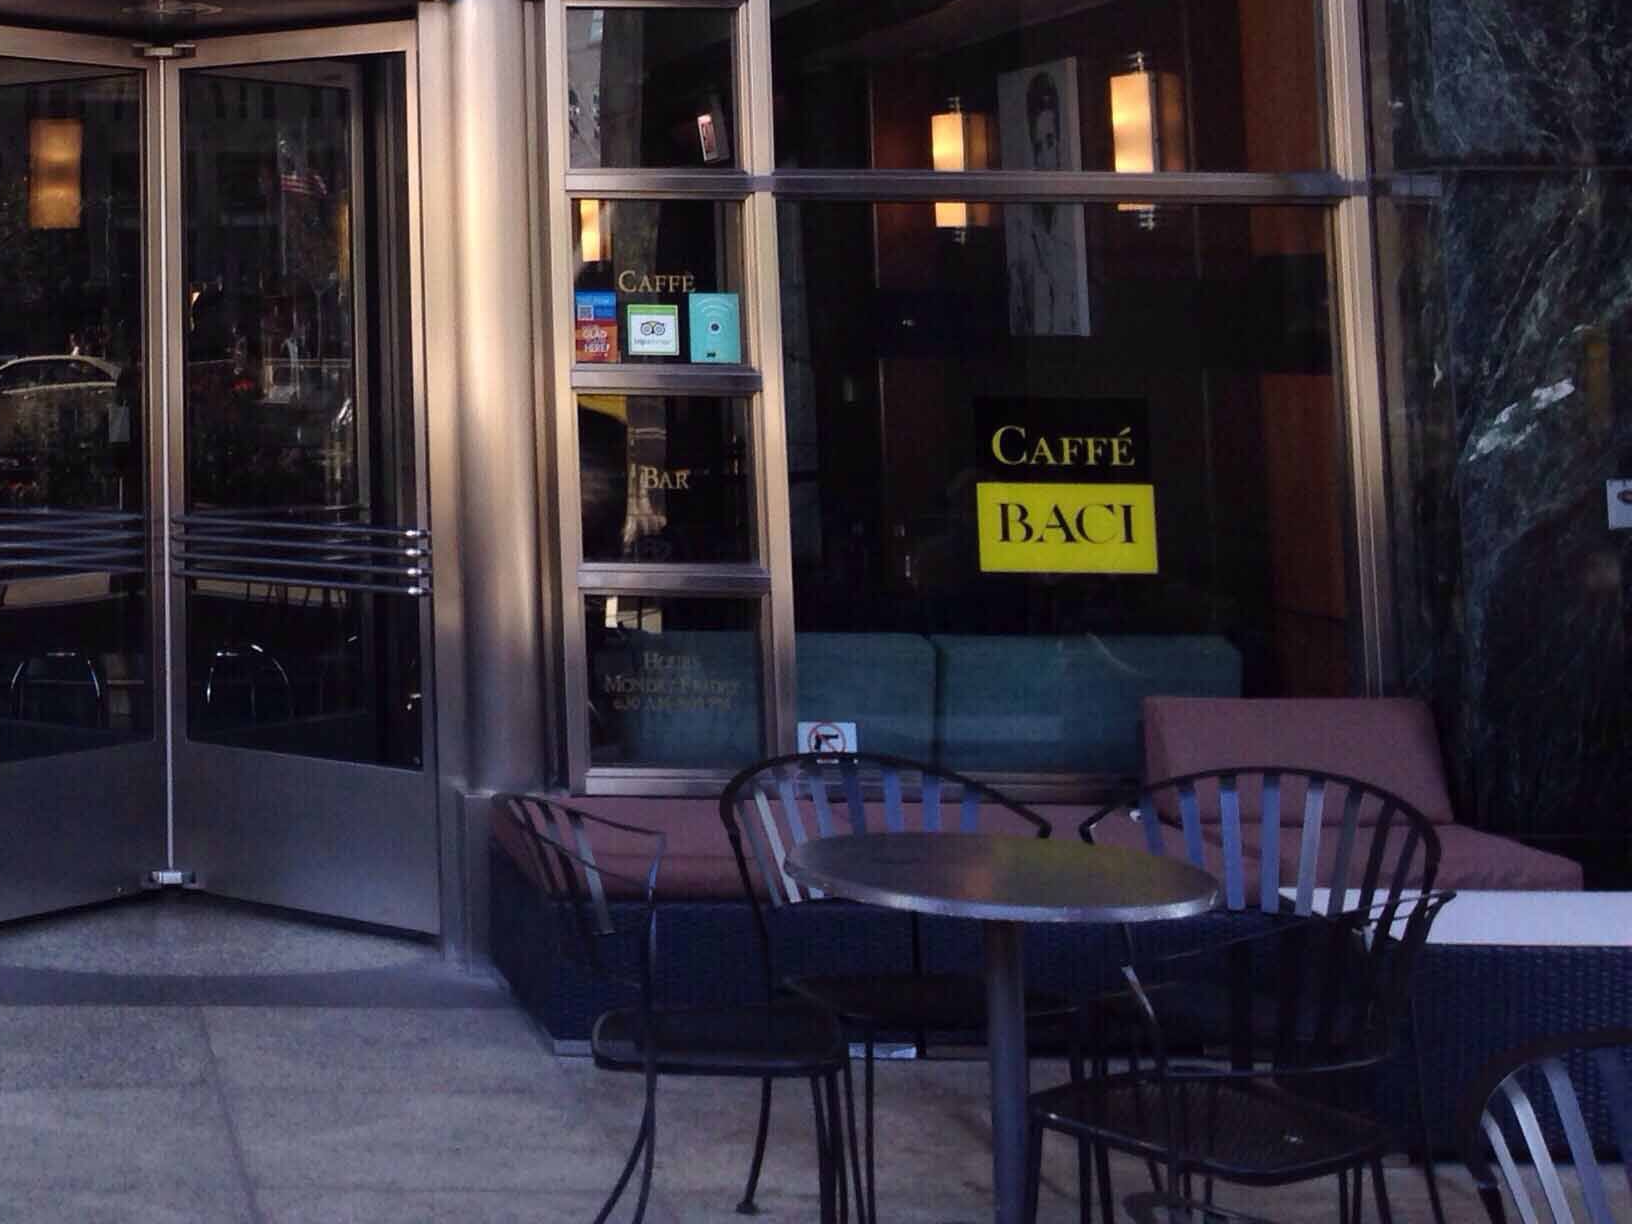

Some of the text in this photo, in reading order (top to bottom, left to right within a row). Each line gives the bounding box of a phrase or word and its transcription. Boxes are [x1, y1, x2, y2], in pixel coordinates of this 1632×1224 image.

[991, 425, 1135, 466] CAFFÉ
[641, 467, 690, 489] BAR
[994, 502, 1136, 544] BACI
